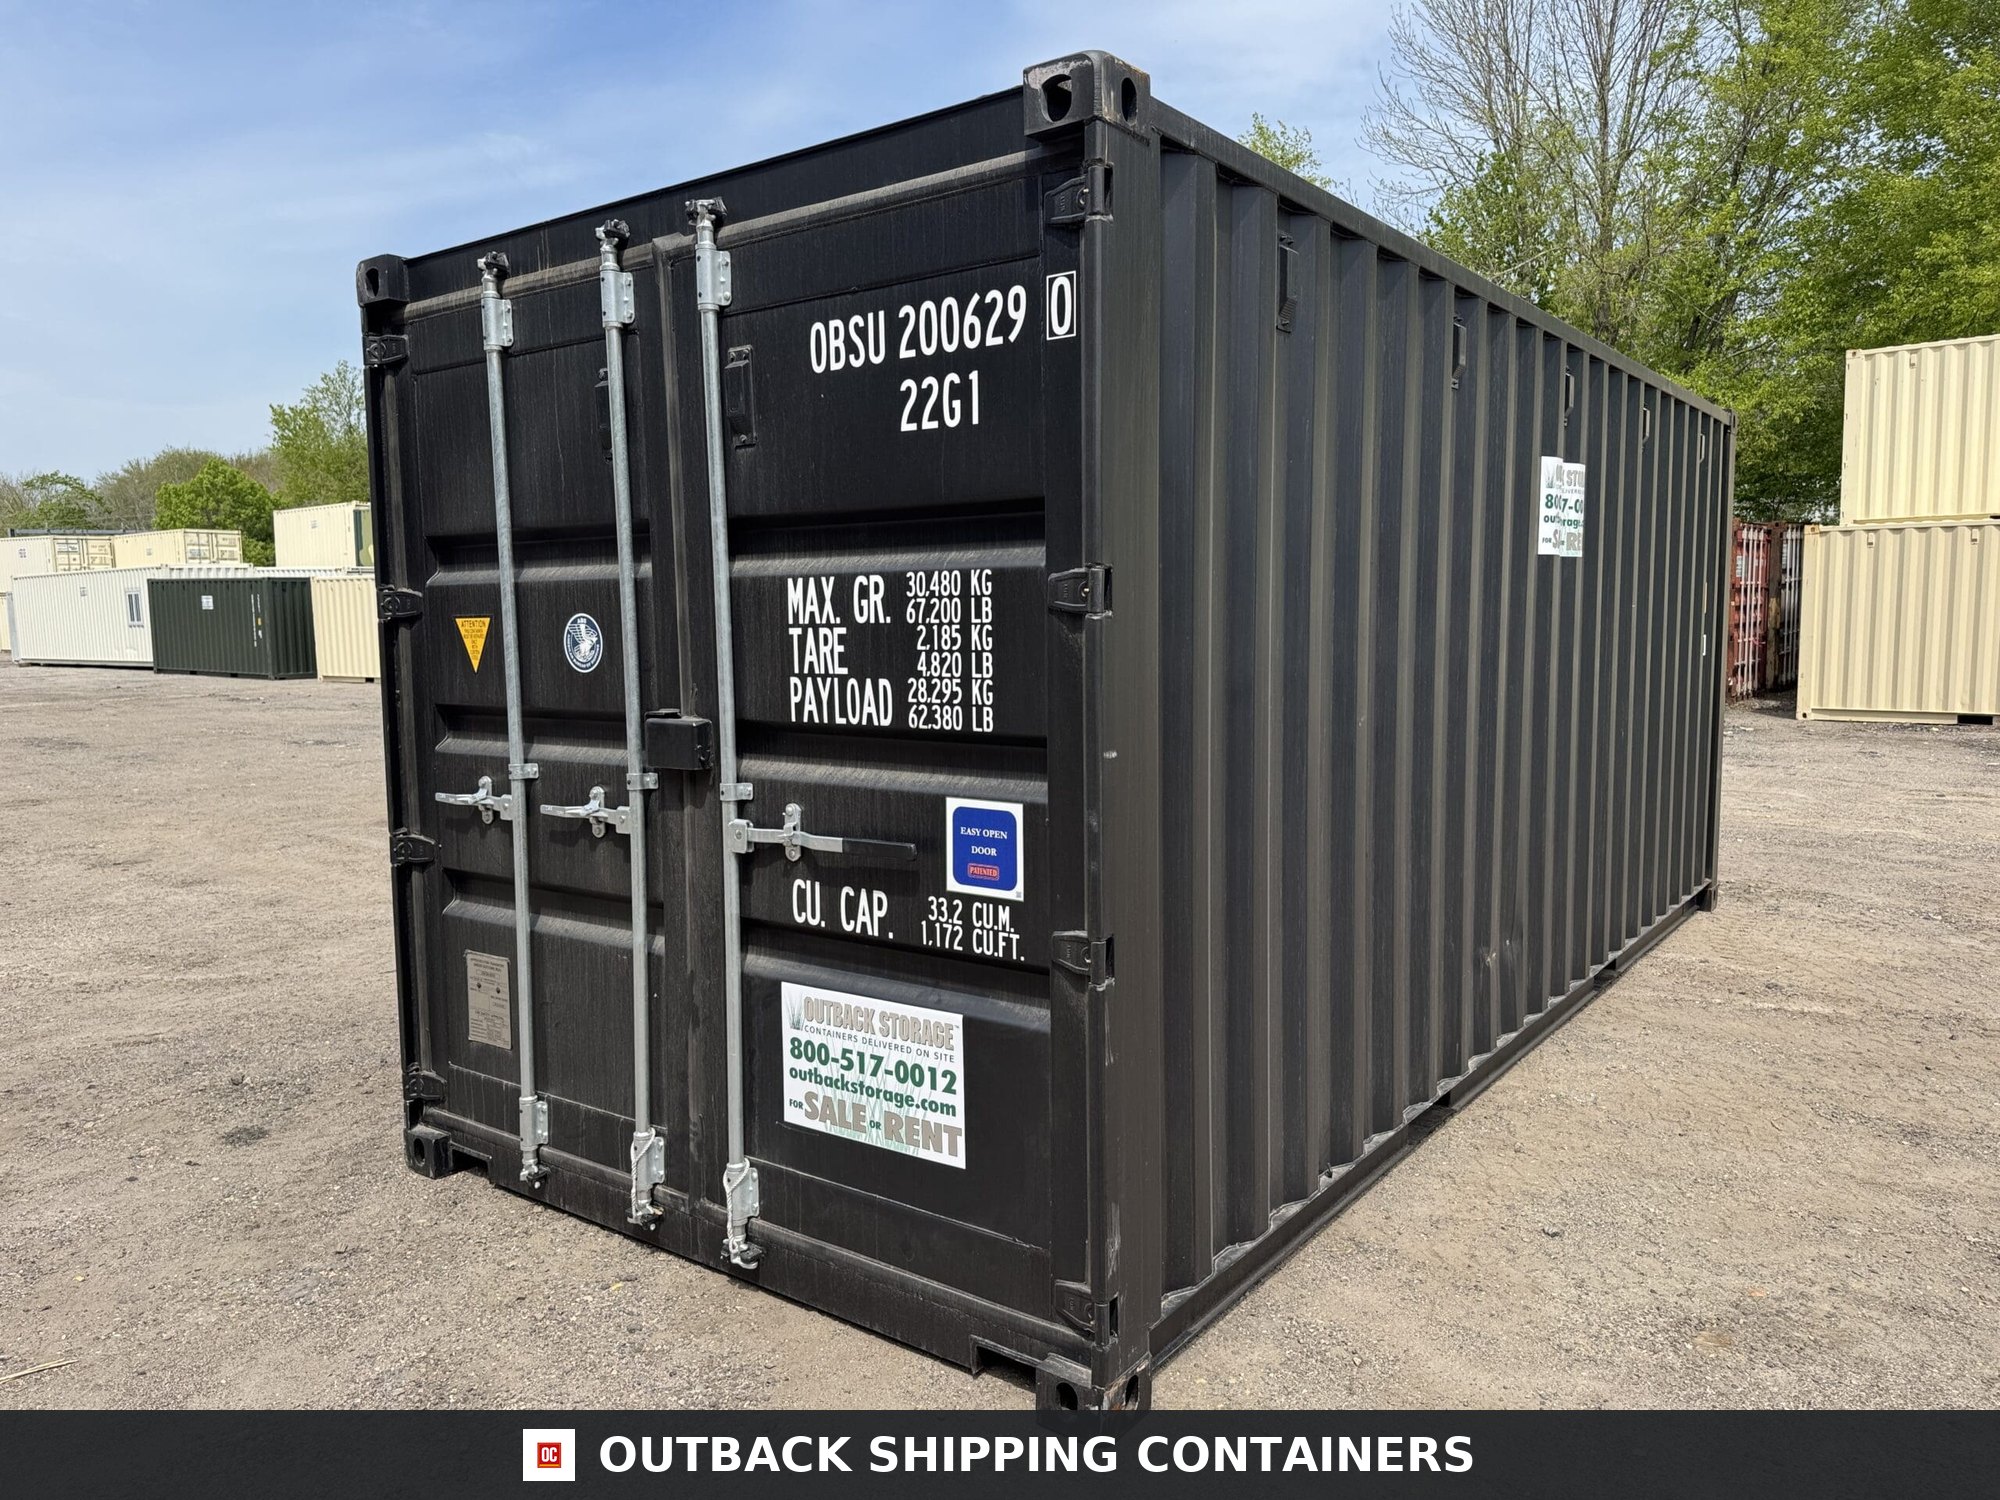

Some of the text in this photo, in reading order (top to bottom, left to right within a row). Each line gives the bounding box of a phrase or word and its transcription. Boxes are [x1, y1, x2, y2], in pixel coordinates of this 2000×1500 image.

[810, 275, 1073, 374] OBSU 200629 0
[900, 369, 979, 432] 22G1
[787, 569, 992, 625] MAX. GR. 30,480 KG
[906, 597, 992, 624] 67,200 LB
[788, 624, 993, 675] TARE 2,185 KG
[917, 651, 993, 678] 4,820 LB
[789, 676, 993, 727] PAYLOAD 28,295 KG
[908, 704, 994, 732] 62,380 LB
[960, 826, 1008, 839] EASY OPEN
[971, 845, 997, 856] DOOR
[969, 866, 998, 877] PATENTED
[792, 878, 1015, 940] CU. CAP. 33.2 CU.M.
[921, 920, 1025, 961] 1,172 CU.FT.
[803, 996, 876, 1036] OUTBACK
[789, 1036, 957, 1095] 800-517-0012
[804, 1024, 955, 1063] CONTAINERS DELIVERED ON SITE
[789, 1067, 957, 1117] outbackstorage.com
[789, 1090, 963, 1157] FOR SALE OR RENT
